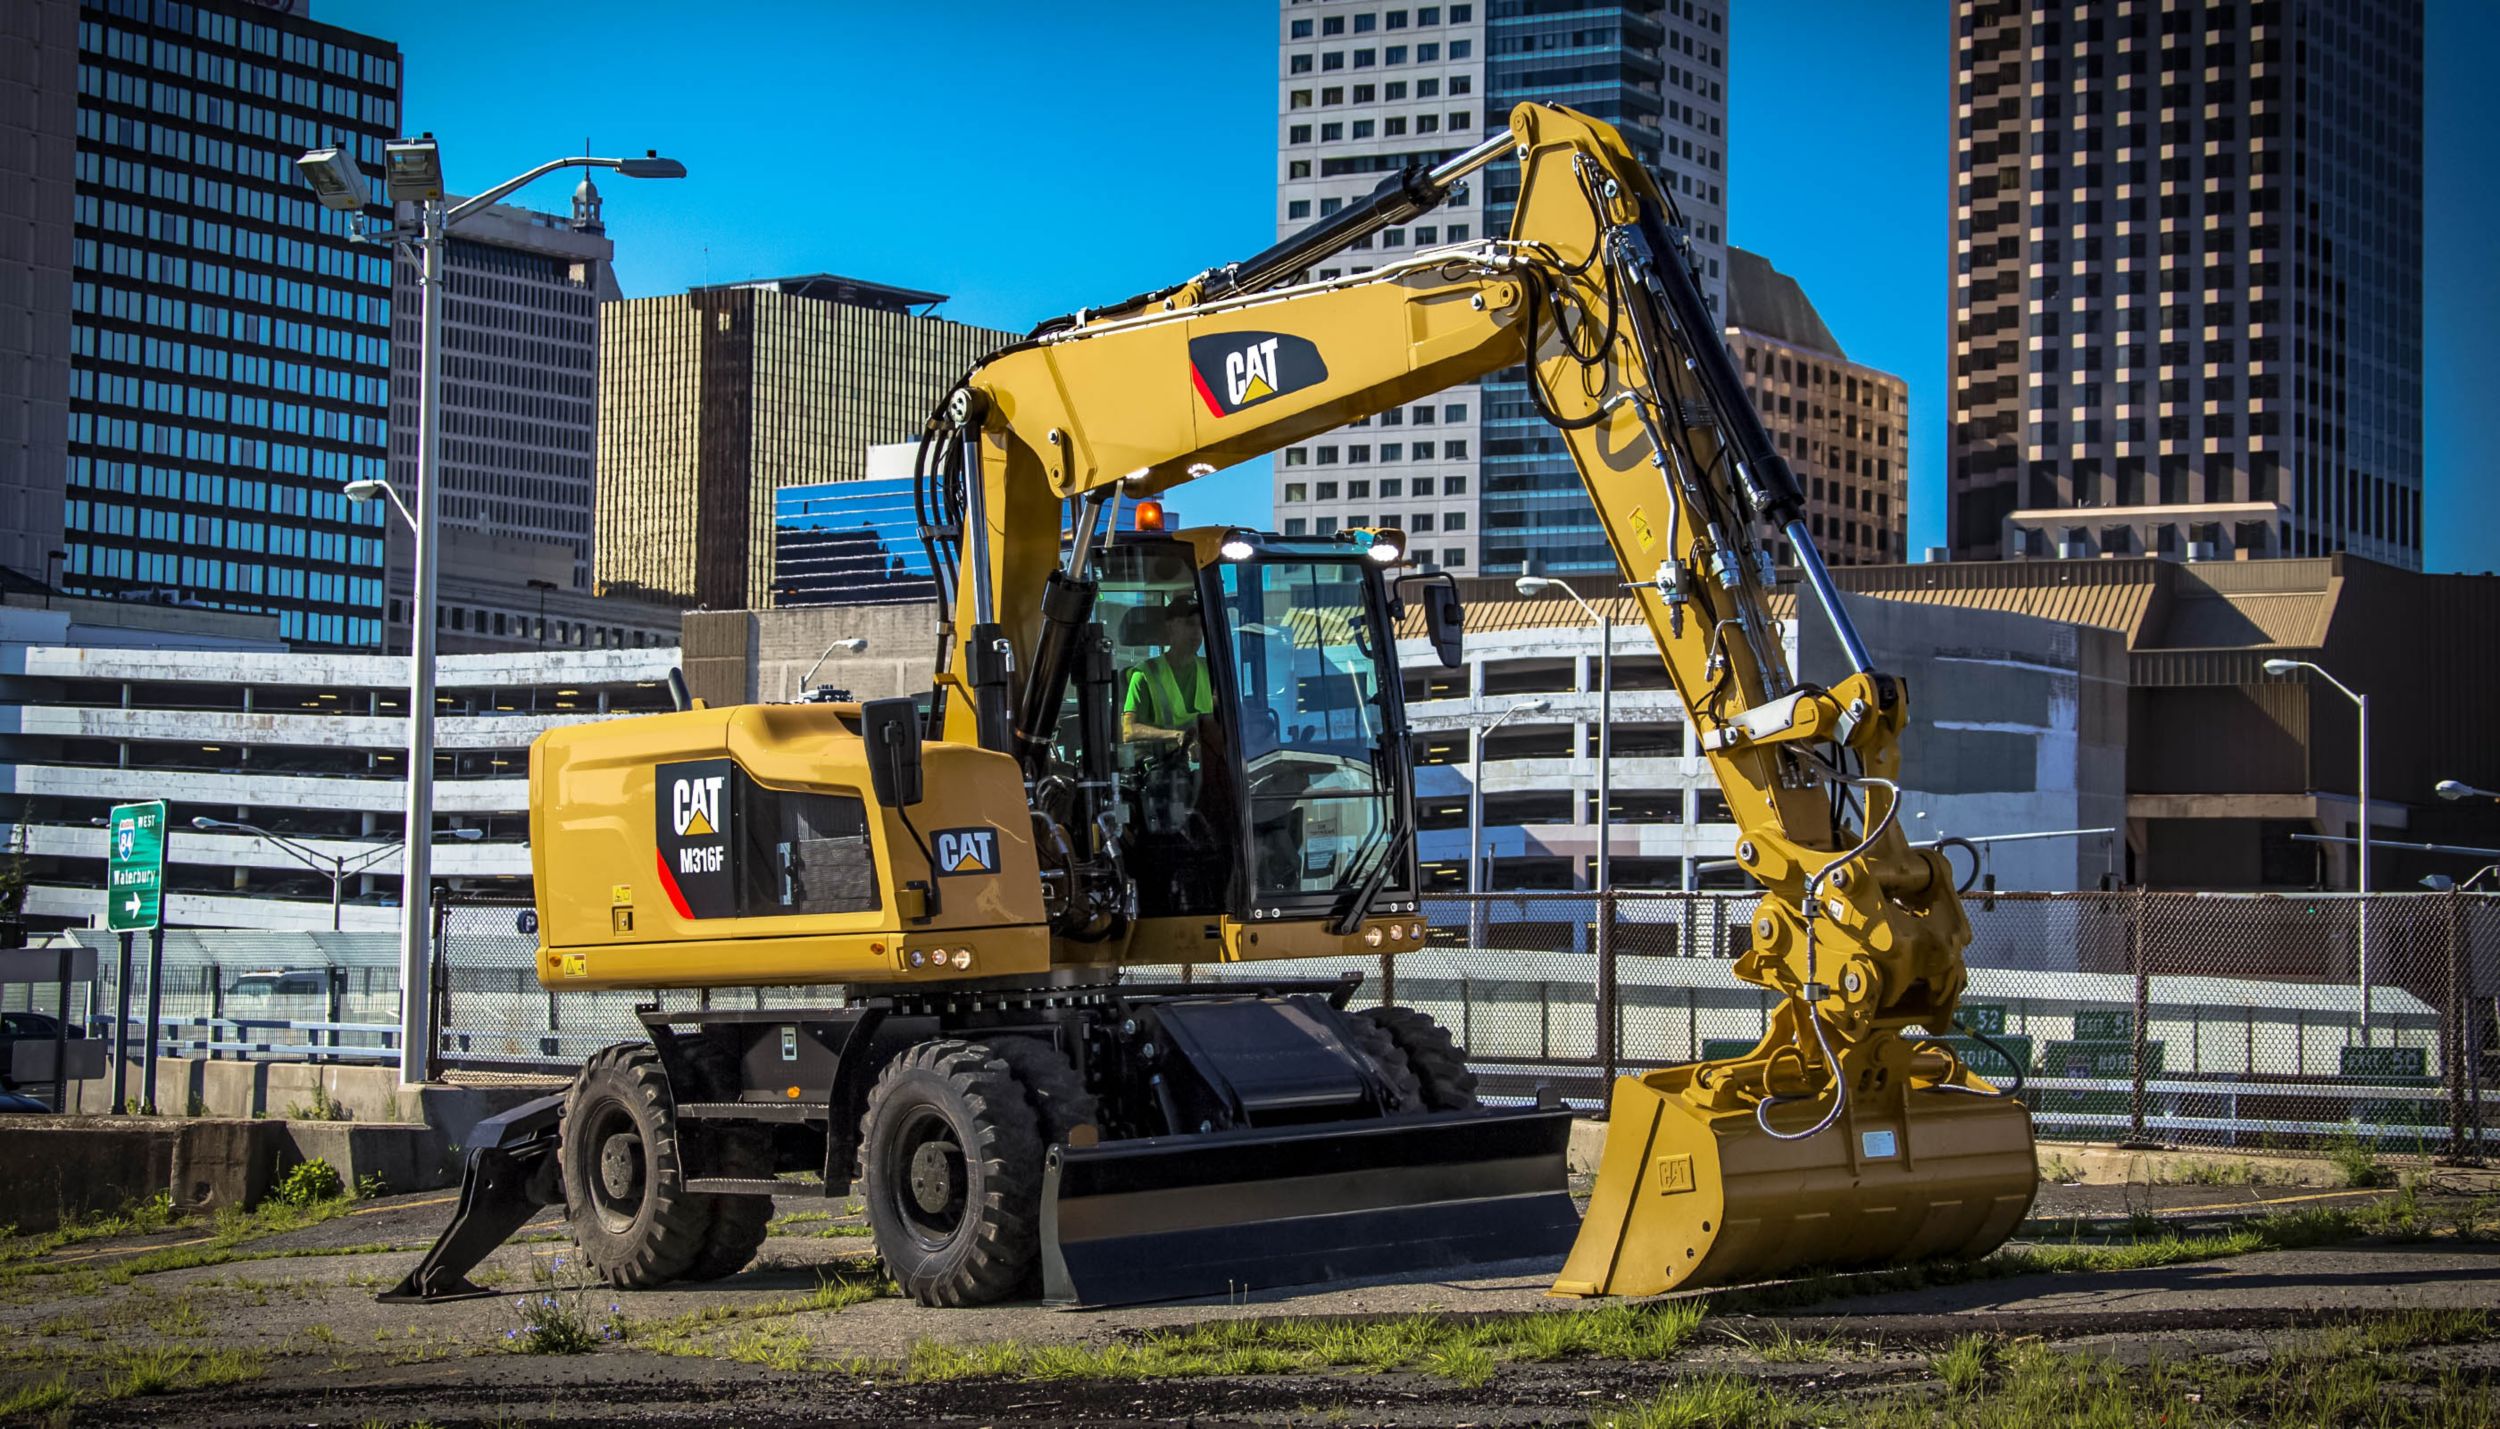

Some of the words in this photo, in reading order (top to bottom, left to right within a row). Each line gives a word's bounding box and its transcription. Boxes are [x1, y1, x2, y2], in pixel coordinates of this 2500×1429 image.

[1226, 337, 1278, 405] CAT
[673, 776, 724, 836] CAT
[138, 815, 156, 829] WEST
[120, 831, 133, 853] 84
[939, 832, 992, 872] CAT
[680, 846, 724, 873] M316F
[113, 868, 156, 887] Waterbury
[1977, 1009, 2000, 1031] 52
[1659, 1159, 1689, 1188] CAT
